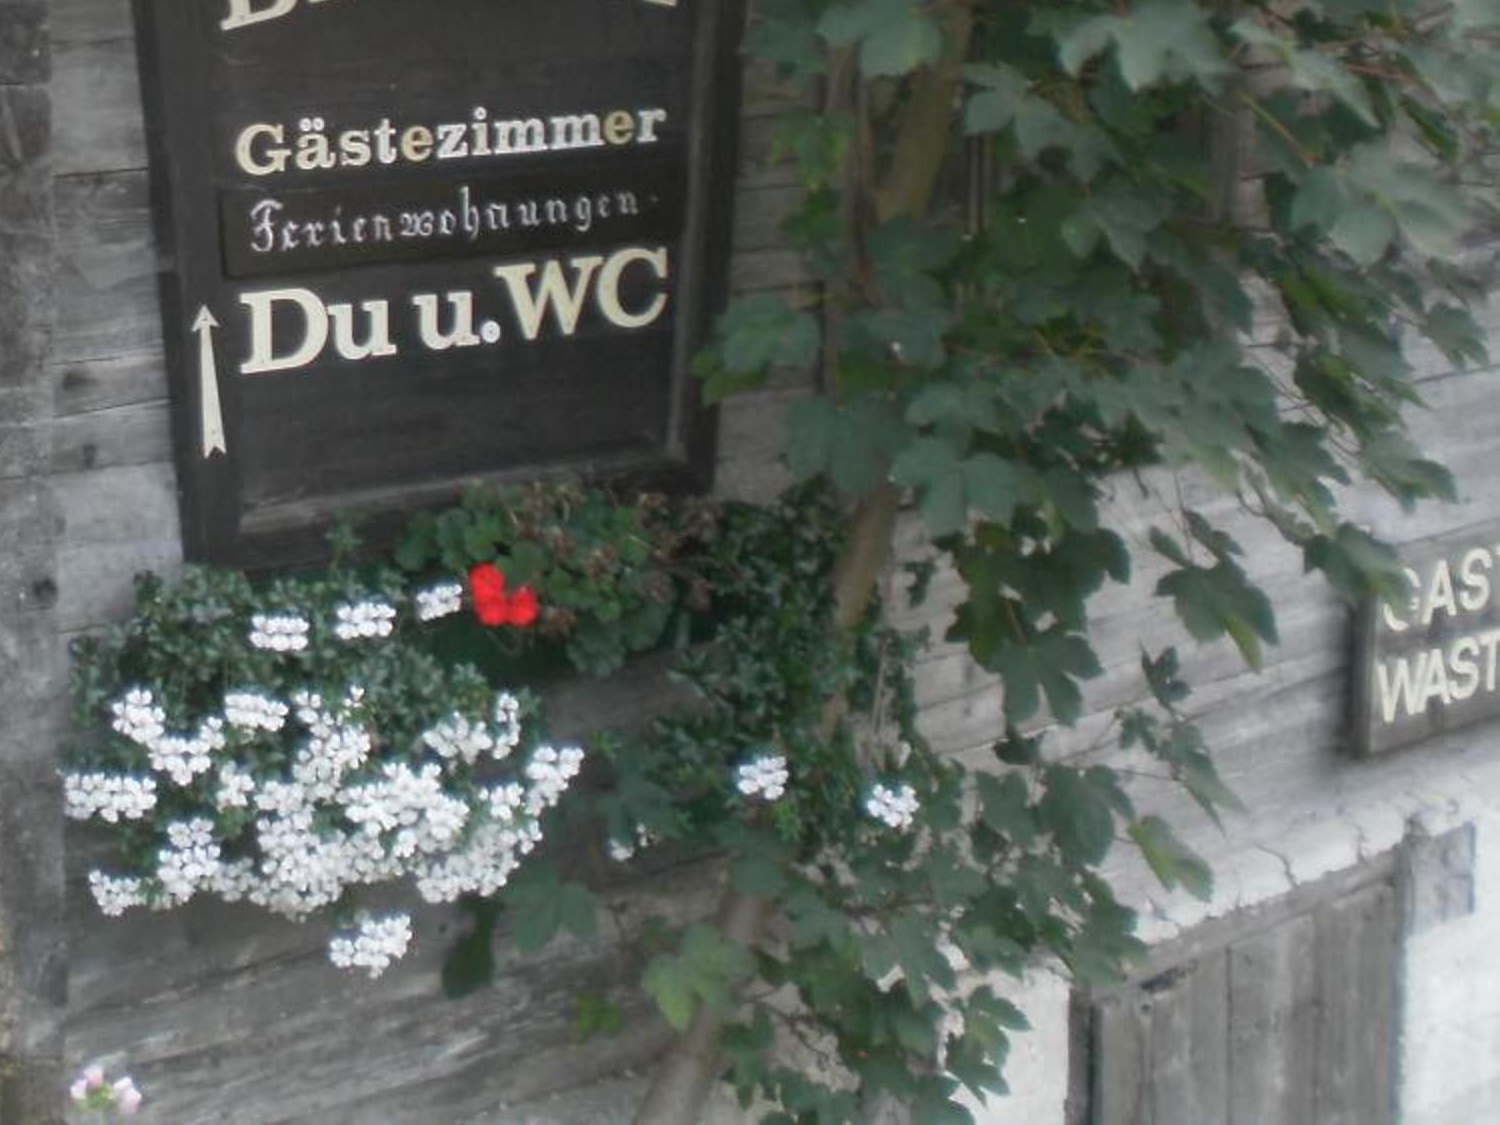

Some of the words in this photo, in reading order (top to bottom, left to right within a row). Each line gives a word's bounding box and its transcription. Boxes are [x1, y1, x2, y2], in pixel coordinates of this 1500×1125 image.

[235, 106, 666, 174] Gästezimmer
[249, 186, 640, 253] Ferienwohnungen
[239, 287, 397, 374] Du
